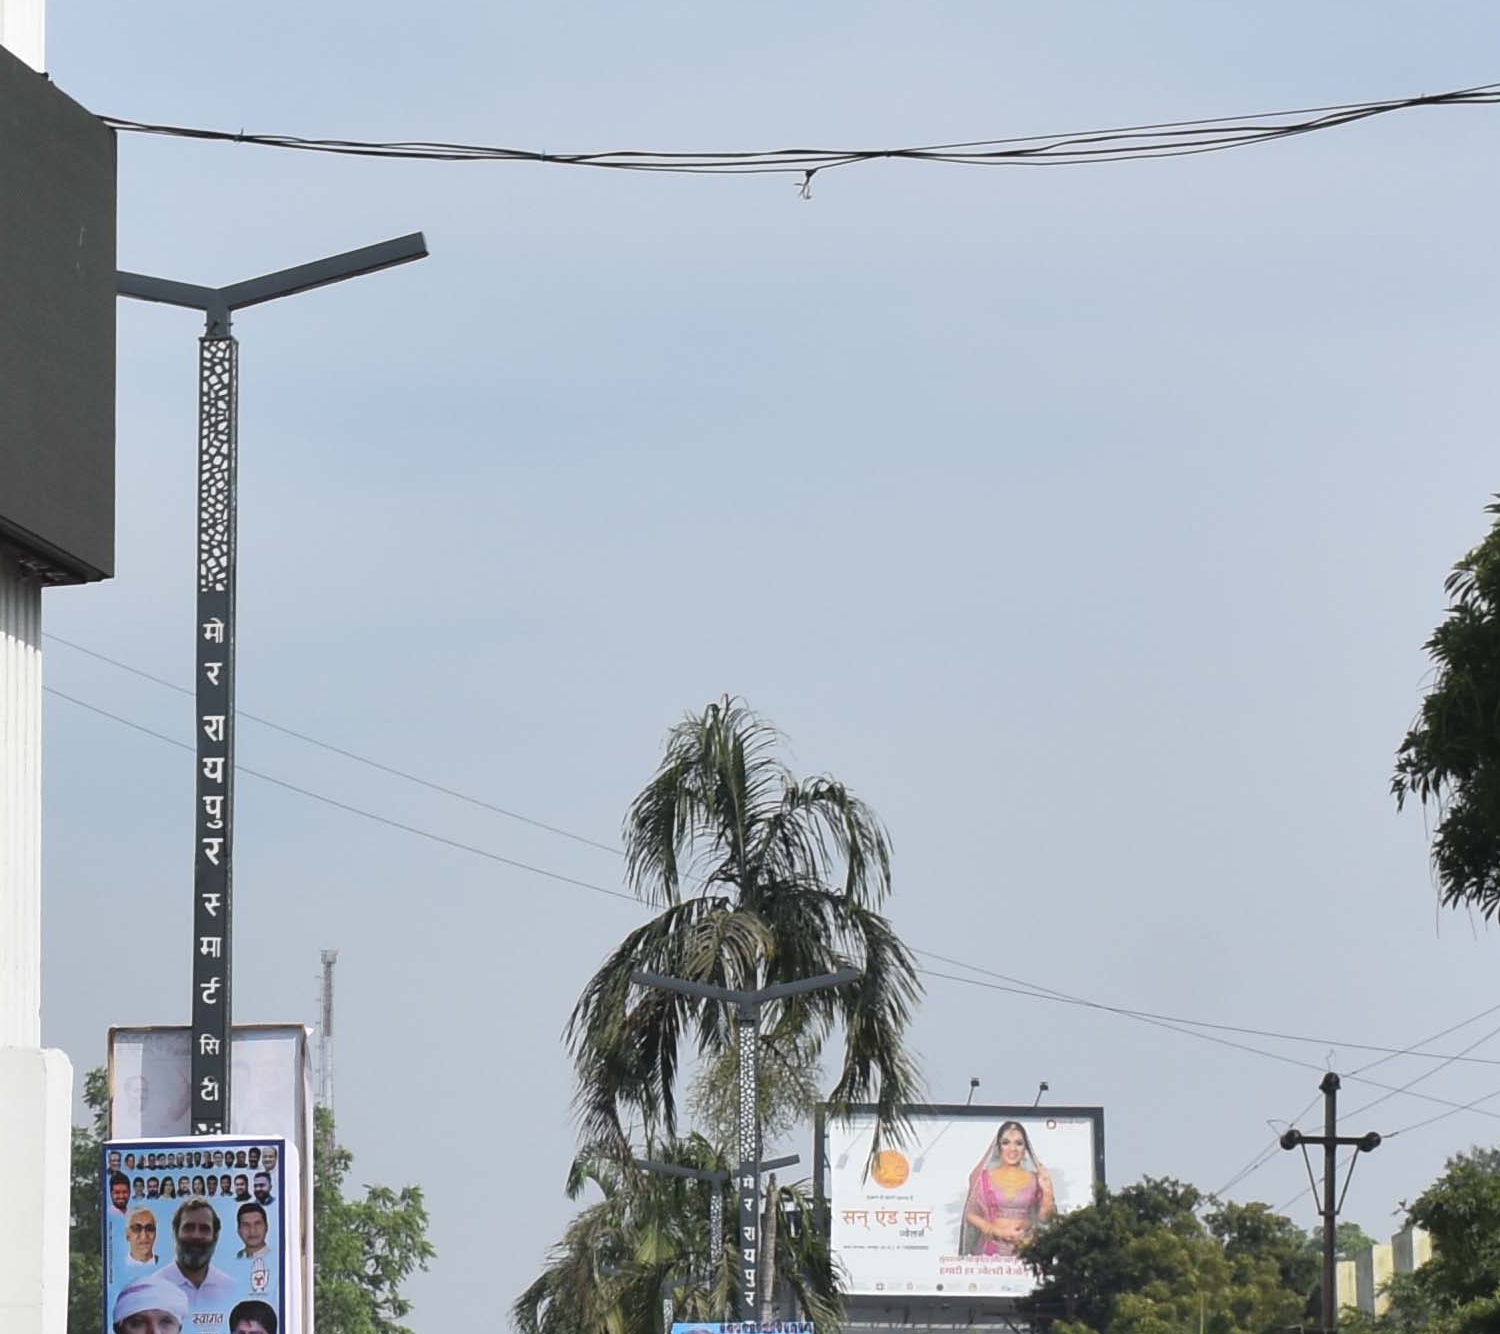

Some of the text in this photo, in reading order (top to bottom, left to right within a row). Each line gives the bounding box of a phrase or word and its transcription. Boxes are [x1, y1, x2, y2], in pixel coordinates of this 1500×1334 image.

[199, 618, 225, 1102] मोर रायपुर स्मार्ट सिटी
